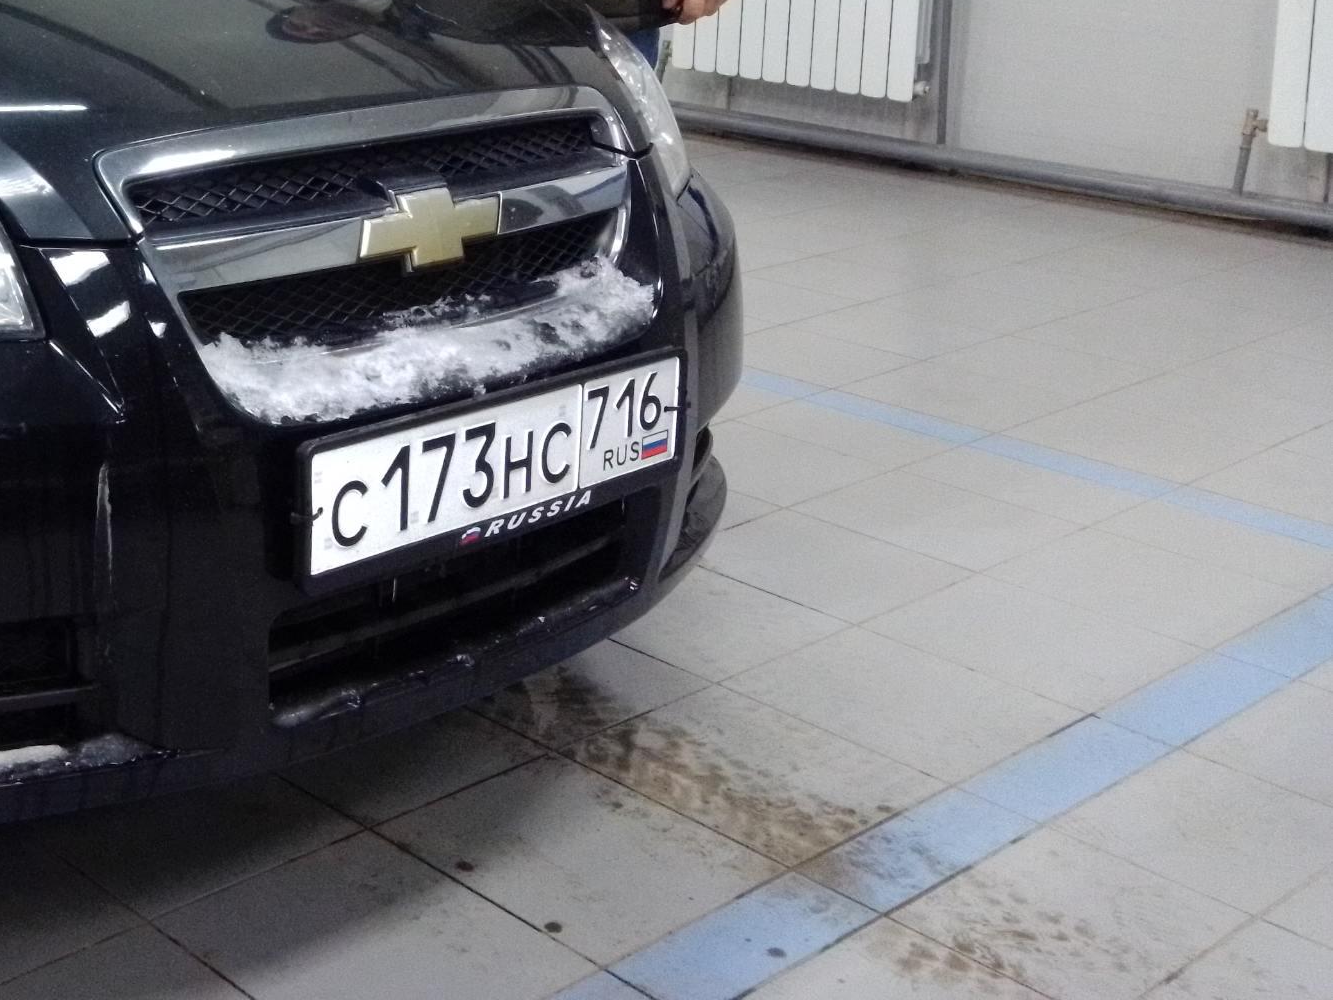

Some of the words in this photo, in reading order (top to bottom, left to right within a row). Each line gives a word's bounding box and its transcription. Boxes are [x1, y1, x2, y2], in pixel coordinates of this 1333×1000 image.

[332, 422, 573, 548] С173НС
[587, 371, 662, 450] 716
[602, 438, 640, 471] RUS
[484, 490, 592, 538] RUSSIA
